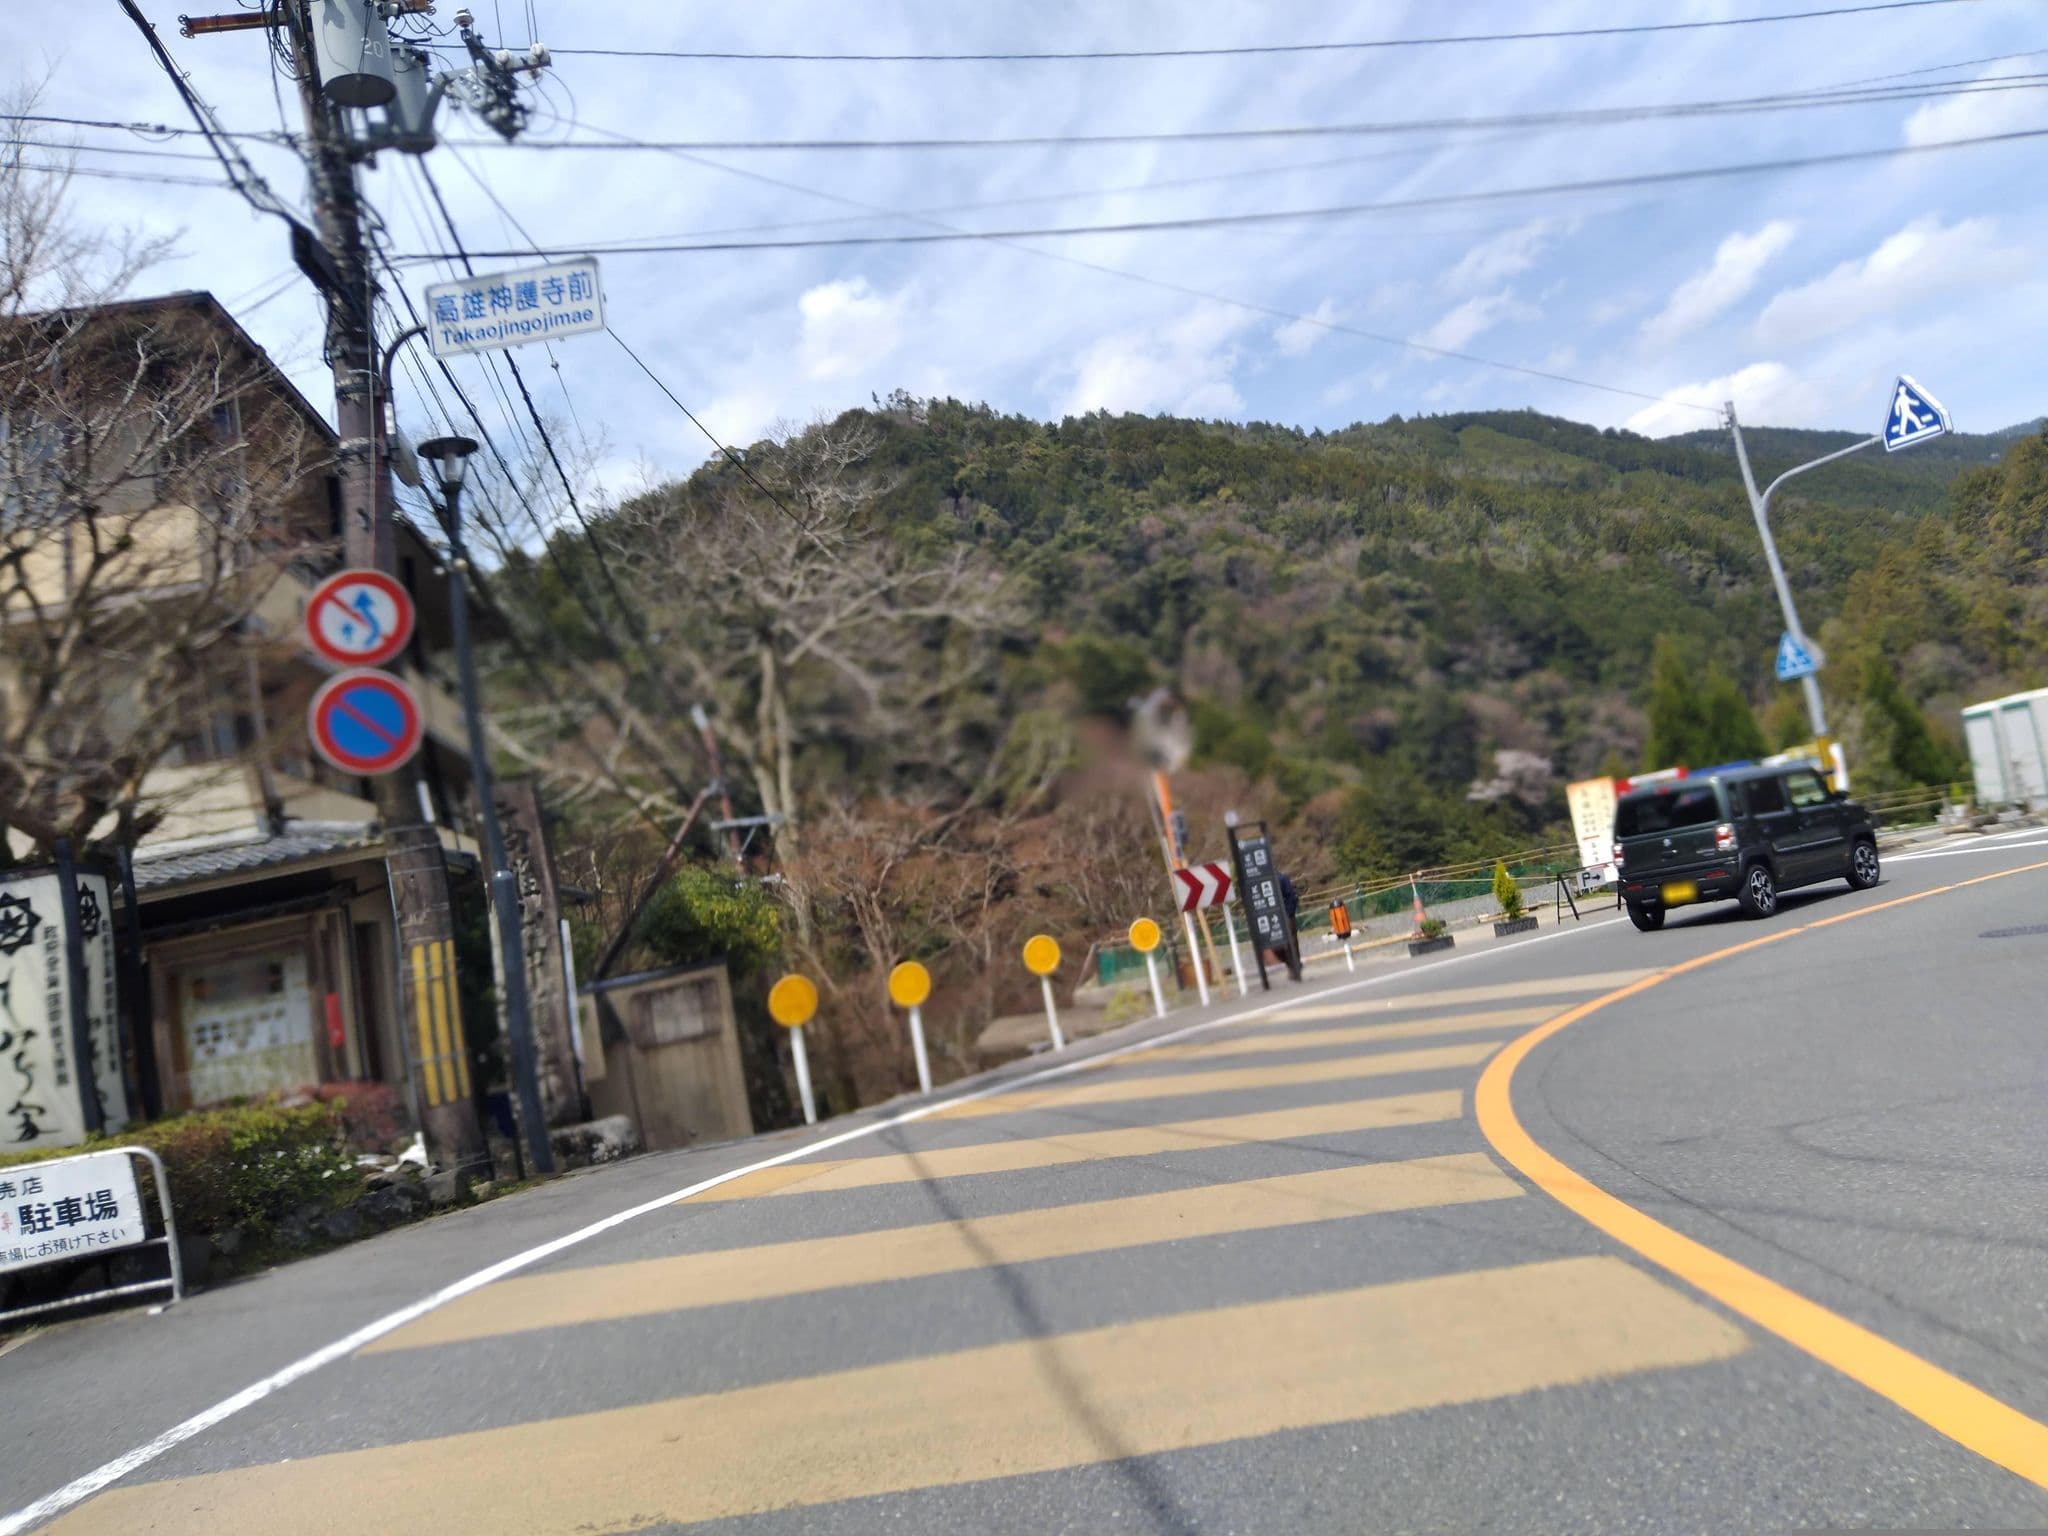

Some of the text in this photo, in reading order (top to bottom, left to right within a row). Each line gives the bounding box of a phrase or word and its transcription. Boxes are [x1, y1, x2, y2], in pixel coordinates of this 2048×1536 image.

[361, 37, 383, 58] 20
[434, 271, 593, 325] 高雄神護寺前
[442, 307, 593, 345] Takaojingojimae
[18, 1189, 118, 1235] 駐車場
